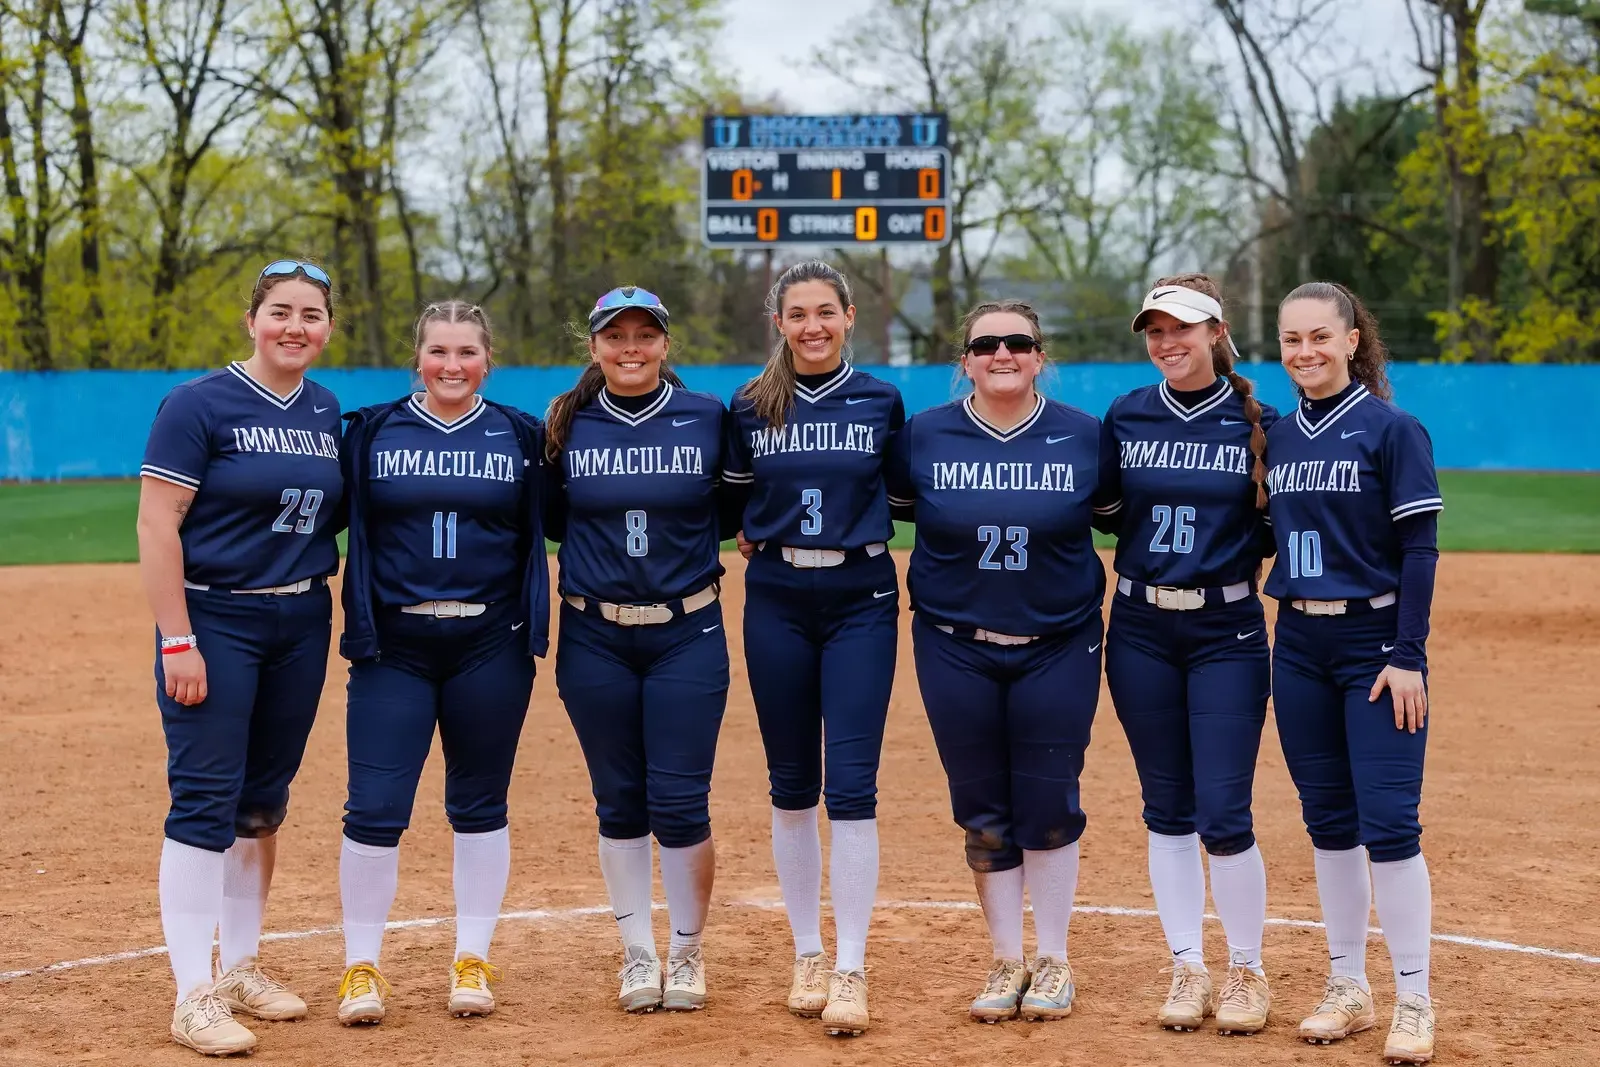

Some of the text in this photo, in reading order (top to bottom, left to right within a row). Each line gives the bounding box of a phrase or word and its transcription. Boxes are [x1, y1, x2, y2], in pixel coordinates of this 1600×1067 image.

[707, 151, 779, 170] VISITOR
[796, 150, 866, 170] INNING
[885, 151, 942, 170] HOME
[732, 169, 753, 201] 0
[772, 172, 789, 191] H
[864, 171, 880, 191] E
[918, 168, 940, 200] 0
[707, 215, 756, 235] BALL
[757, 207, 779, 241] 0
[789, 214, 855, 235] STRIKE
[855, 206, 877, 241] 0
[887, 214, 924, 234] OUT
[924, 206, 945, 241] 0
[751, 422, 876, 459] IMMACULATA
[1120, 440, 1248, 475] IMMACULATA
[376, 449, 515, 483] IMMACULATA
[568, 446, 703, 478] IMMACULATA
[932, 462, 1075, 492] IMMACULATA
[271, 488, 324, 535] 29
[800, 488, 822, 536] 3
[431, 511, 457, 559] 11
[625, 509, 648, 557] 8
[1149, 504, 1196, 554] 26
[977, 525, 1029, 571] 23
[1287, 530, 1323, 579] 10
